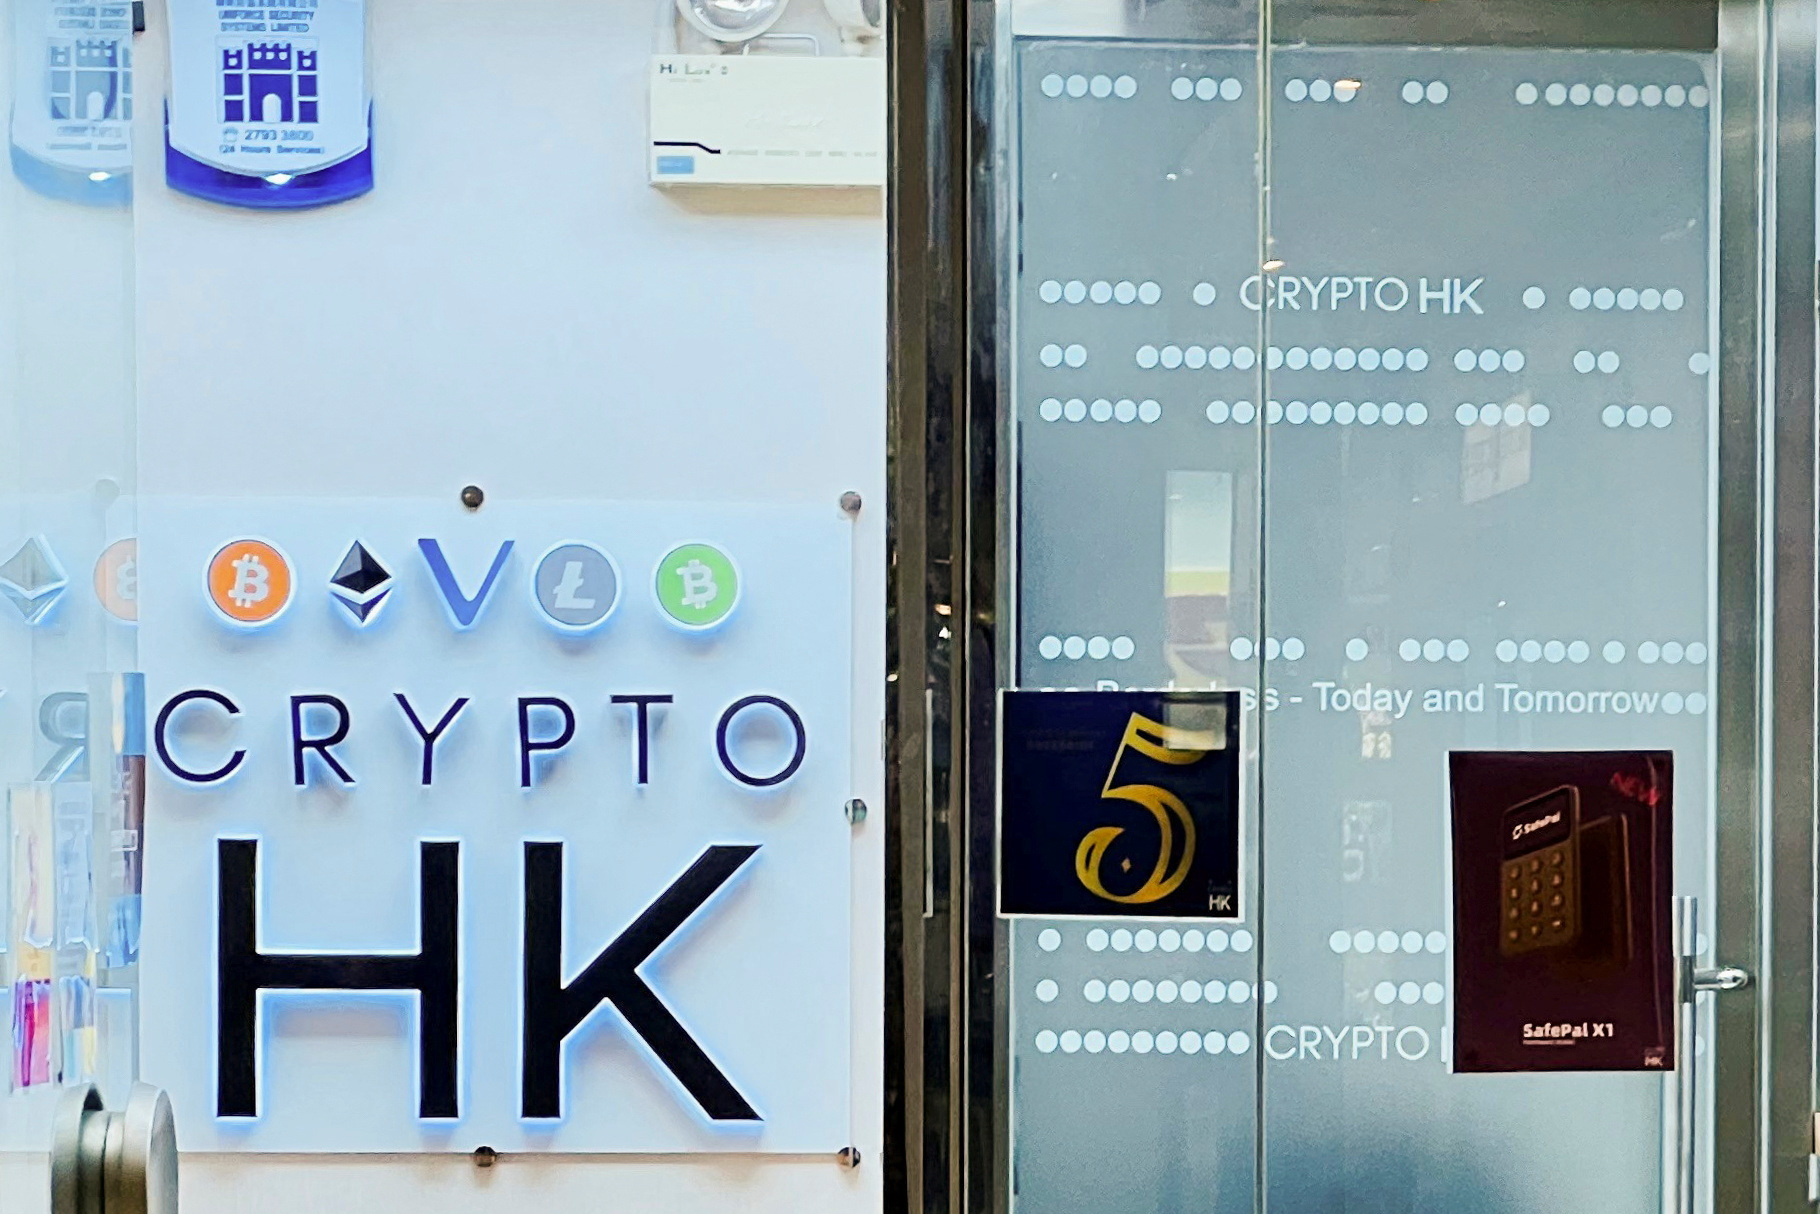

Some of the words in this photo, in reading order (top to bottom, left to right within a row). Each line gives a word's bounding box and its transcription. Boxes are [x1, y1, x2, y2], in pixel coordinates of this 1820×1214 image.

[1239, 275, 1409, 312] CRYPTO
[1418, 276, 1485, 315] HK
[1312, 681, 1413, 719] Today
[1422, 682, 1484, 713] and
[1494, 682, 1660, 714] Tomorrow
[154, 689, 806, 788] CRYPTO
[1208, 893, 1231, 911] HK
[216, 838, 763, 1121] HK
[1264, 1024, 1430, 1061] CRYPTO
[1522, 1022, 1588, 1038] SafePal
[1592, 1023, 1614, 1038] X1
